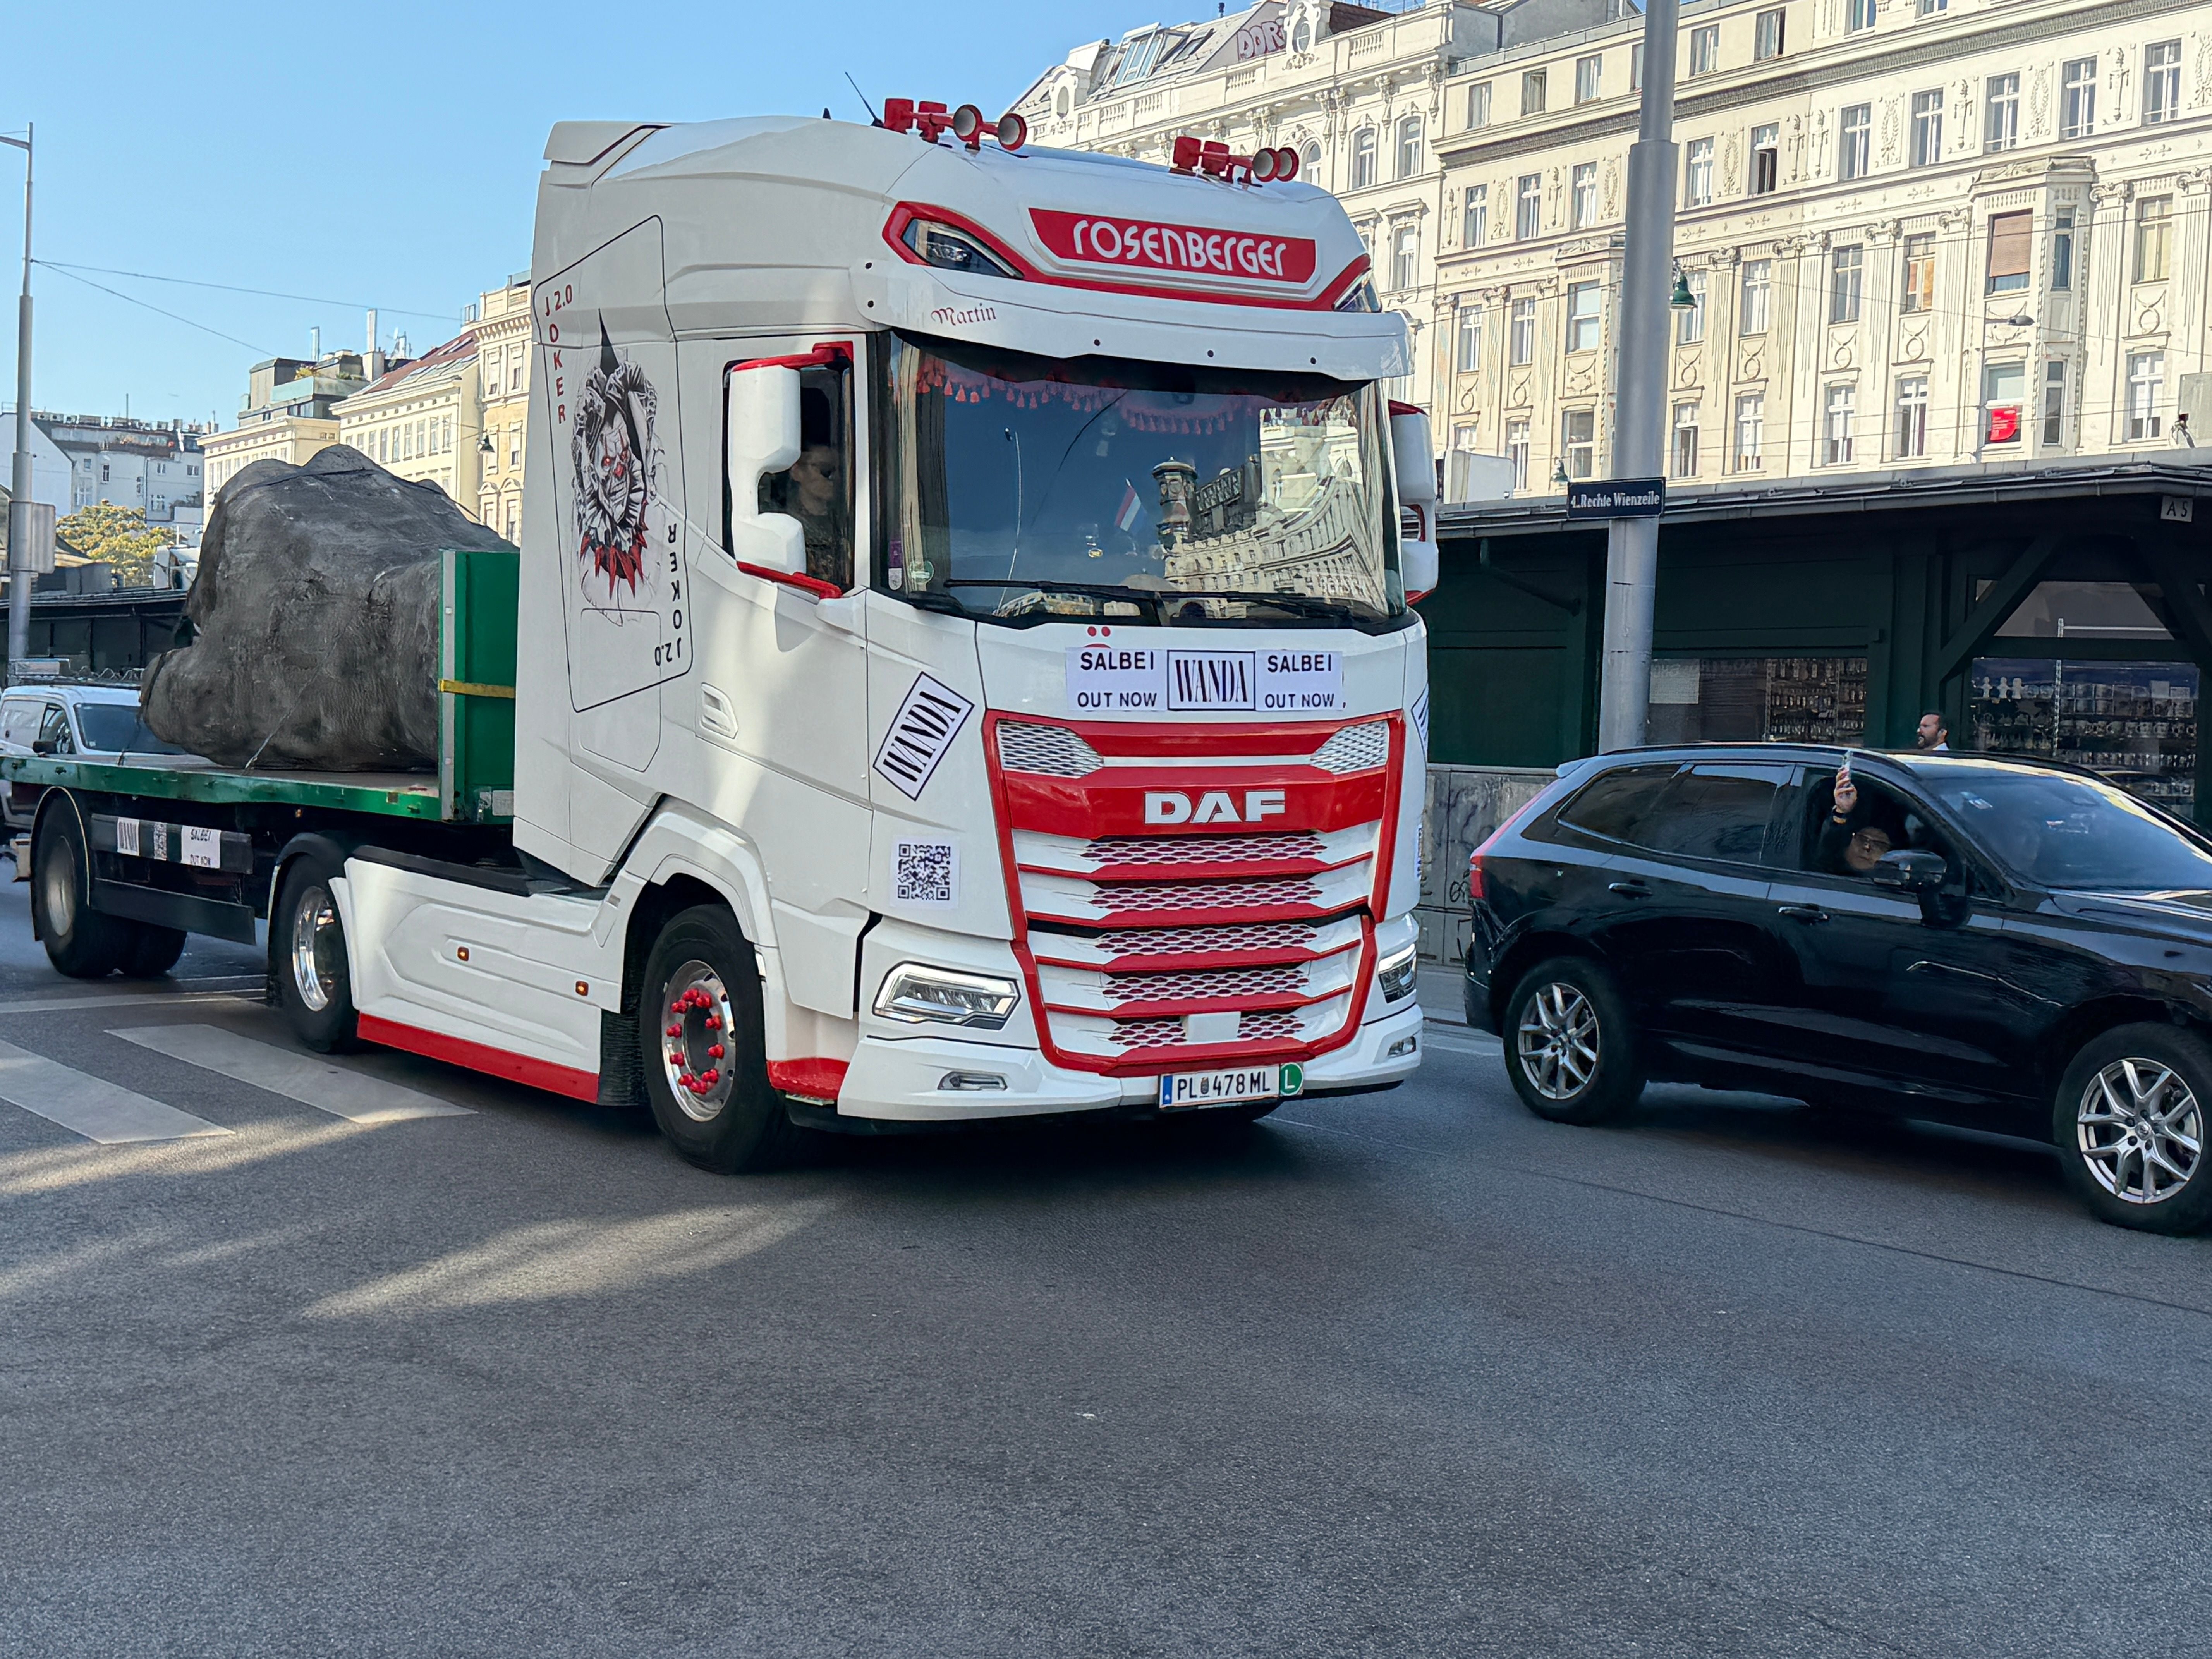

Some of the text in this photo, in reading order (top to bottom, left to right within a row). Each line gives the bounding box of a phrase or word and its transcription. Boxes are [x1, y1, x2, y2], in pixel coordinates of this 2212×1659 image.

[1073, 220, 1286, 276] ROSENBERGER
[931, 302, 996, 326] Martin
[1613, 490, 1660, 507] Wienzeile
[1080, 651, 1154, 670] SALBEI
[1267, 654, 1331, 673] SALBEI
[1175, 659, 1248, 702] WANDA
[1077, 692, 1157, 708] OUT NOW
[1265, 693, 1334, 708] OUT NOW
[883, 691, 962, 782] WANDA
[1144, 790, 1285, 824] DAF
[1177, 1077, 1197, 1100] PL
[1285, 1069, 1295, 1089] L
